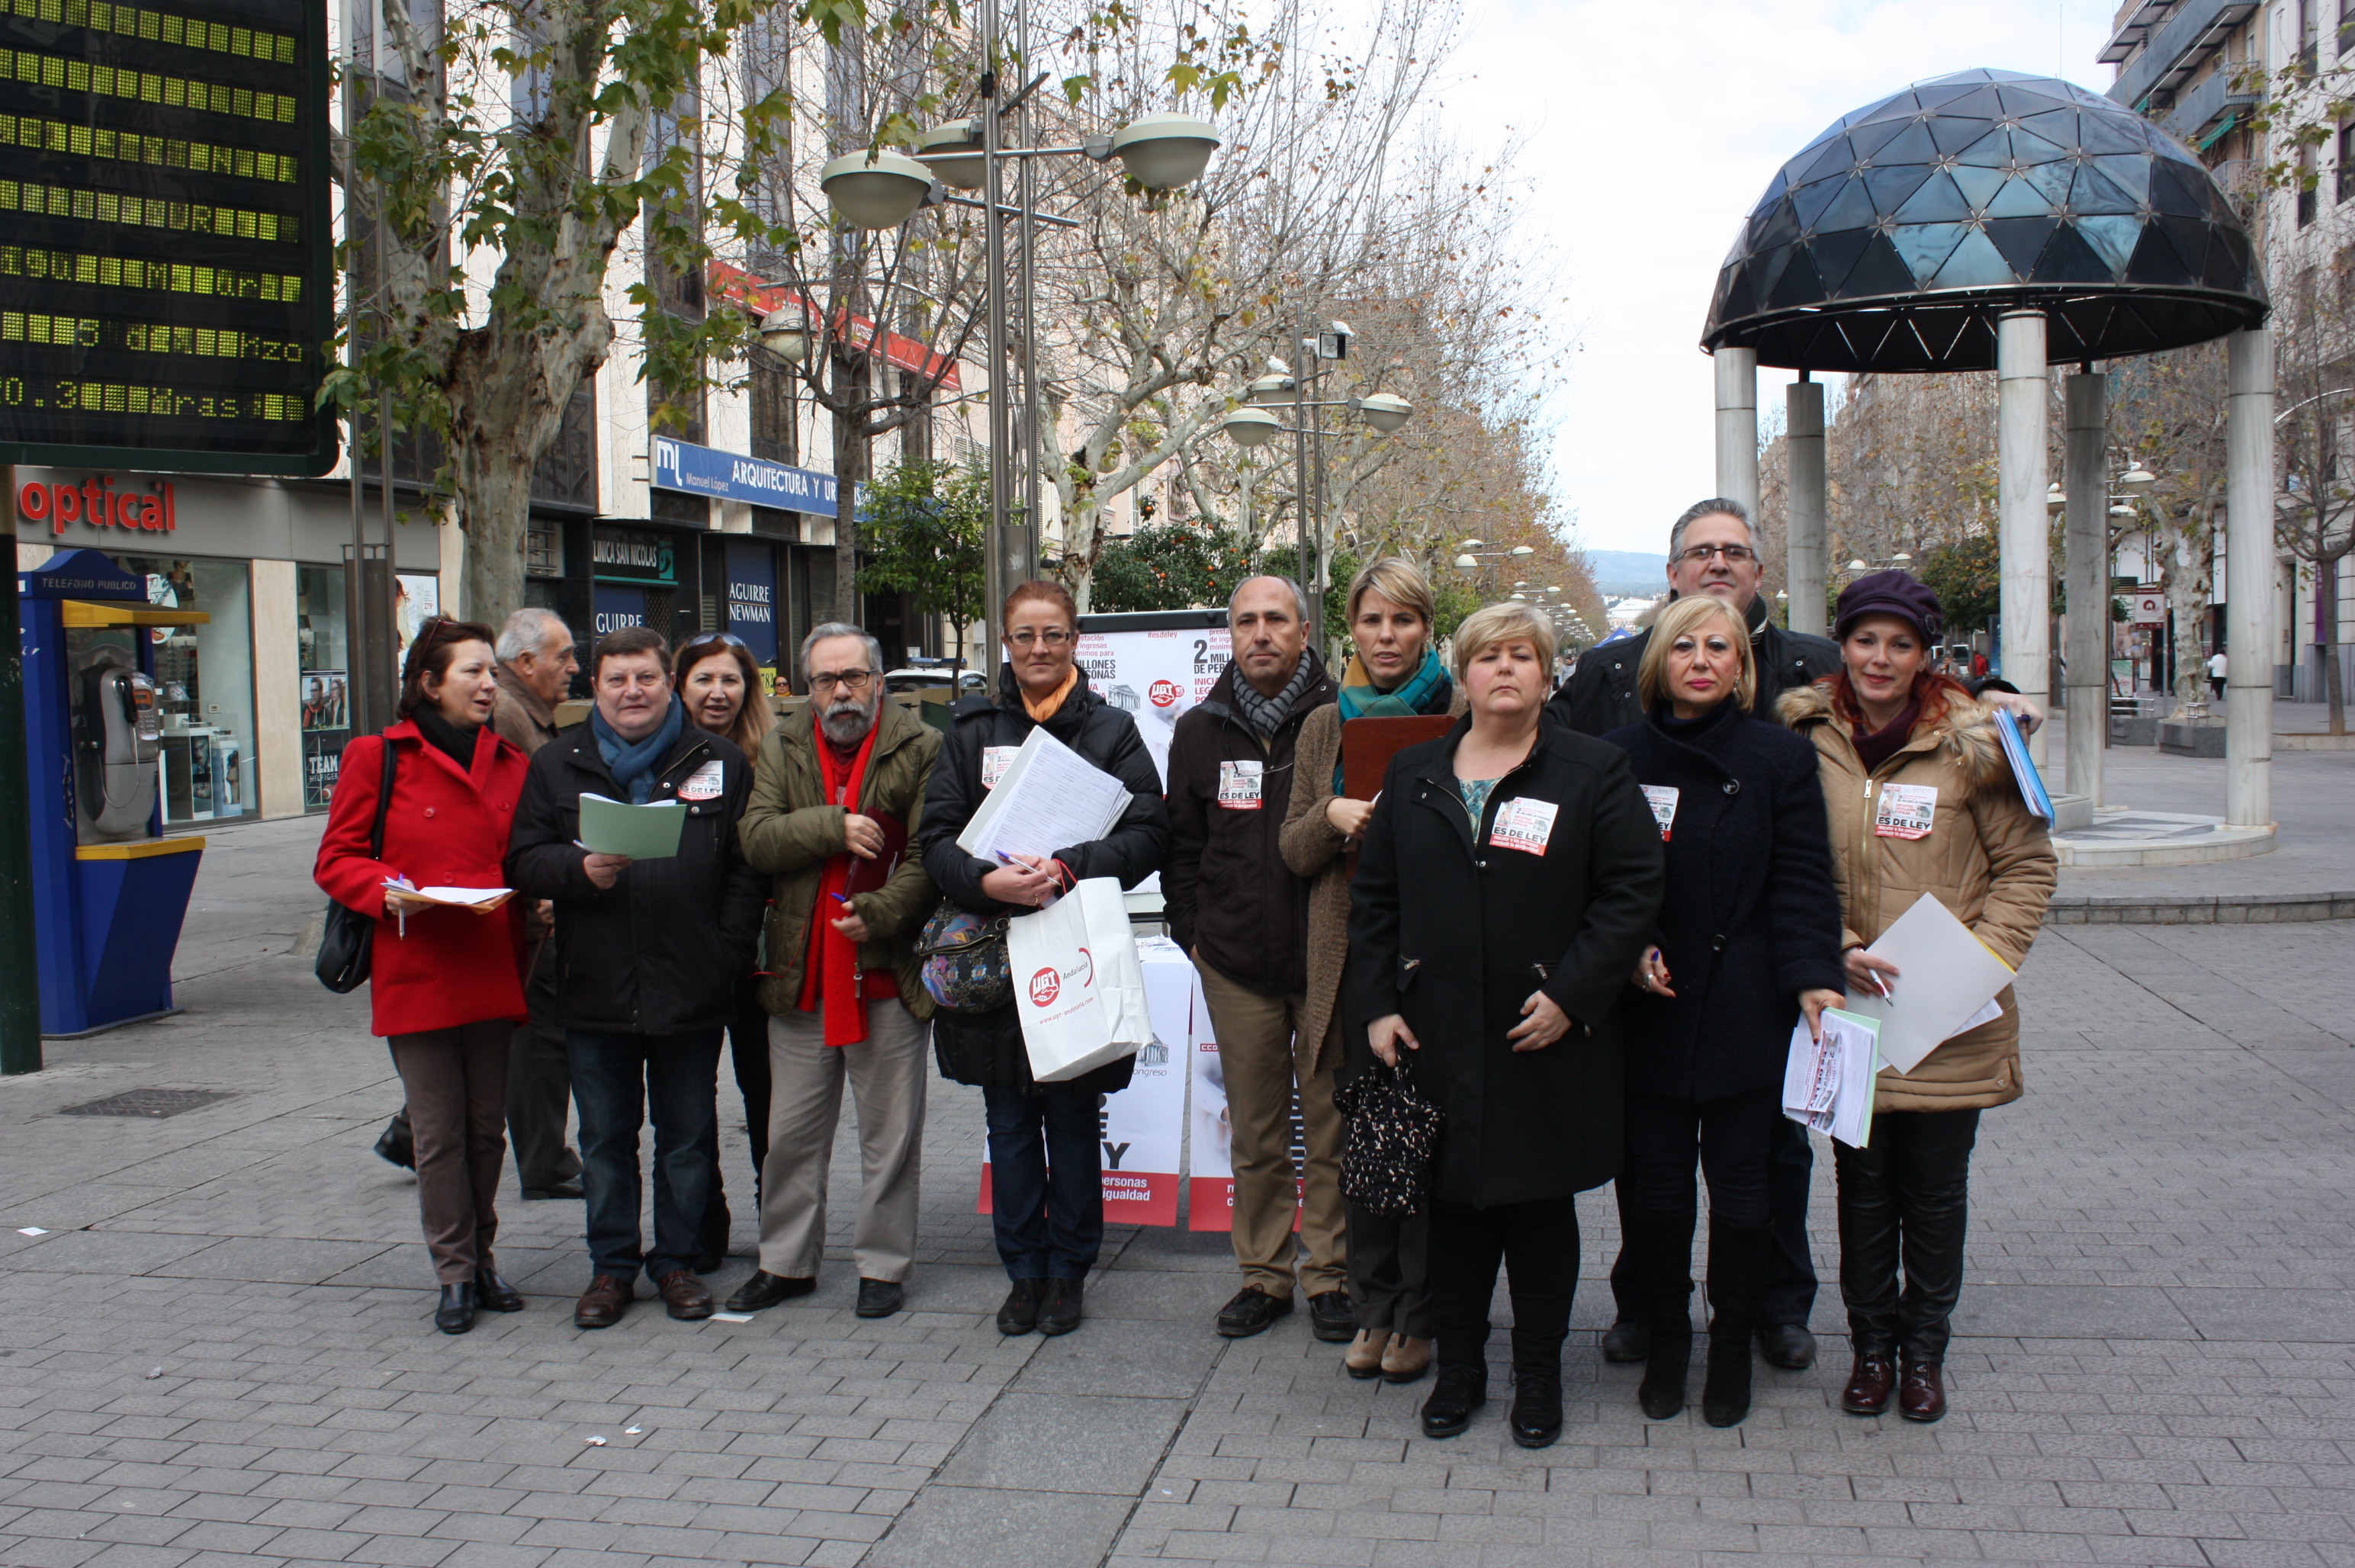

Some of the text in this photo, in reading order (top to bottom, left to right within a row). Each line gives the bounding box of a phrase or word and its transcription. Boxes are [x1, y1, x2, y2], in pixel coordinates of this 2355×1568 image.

[686, 472, 729, 493] Manuel López
[731, 460, 808, 497] ARQUITECTURA
[813, 477, 820, 499] Y
[20, 476, 176, 535] optical
[593, 540, 657, 567] LINICA SAN NICOLAS
[42, 577, 137, 591] TELEFONO PUBLICO
[729, 582, 769, 602] AGUIRRE
[729, 603, 770, 623] NEWMAN
[596, 612, 642, 633] GUIRRE
[1147, 631, 1178, 640] #esdeley
[1080, 642, 1107, 651] ingresos
[1194, 638, 1230, 664] 2 MILL
[1078, 659, 1116, 670] ILLONES
[1194, 664, 1206, 674] DE
[1087, 670, 1116, 680] SONAS
[1152, 683, 1173, 696] UGT
[309, 754, 339, 774] TEAM
[309, 773, 339, 782] HILFIGER
[1658, 821, 1670, 830] EY
[1878, 816, 1891, 825] ES
[1893, 818, 1907, 827] DE
[1910, 820, 1931, 830] LEY
[1493, 826, 1507, 835] ES
[1509, 829, 1524, 838] DE
[1525, 832, 1547, 843] LEY
[1032, 970, 1057, 994] UGT
[1039, 997, 1094, 1025] www.ugt-andalucia.com
[1133, 1068, 1167, 1077] ongreso
[1102, 1177, 1147, 1188] ersonas
[1103, 1188, 1150, 1202] igualdad
